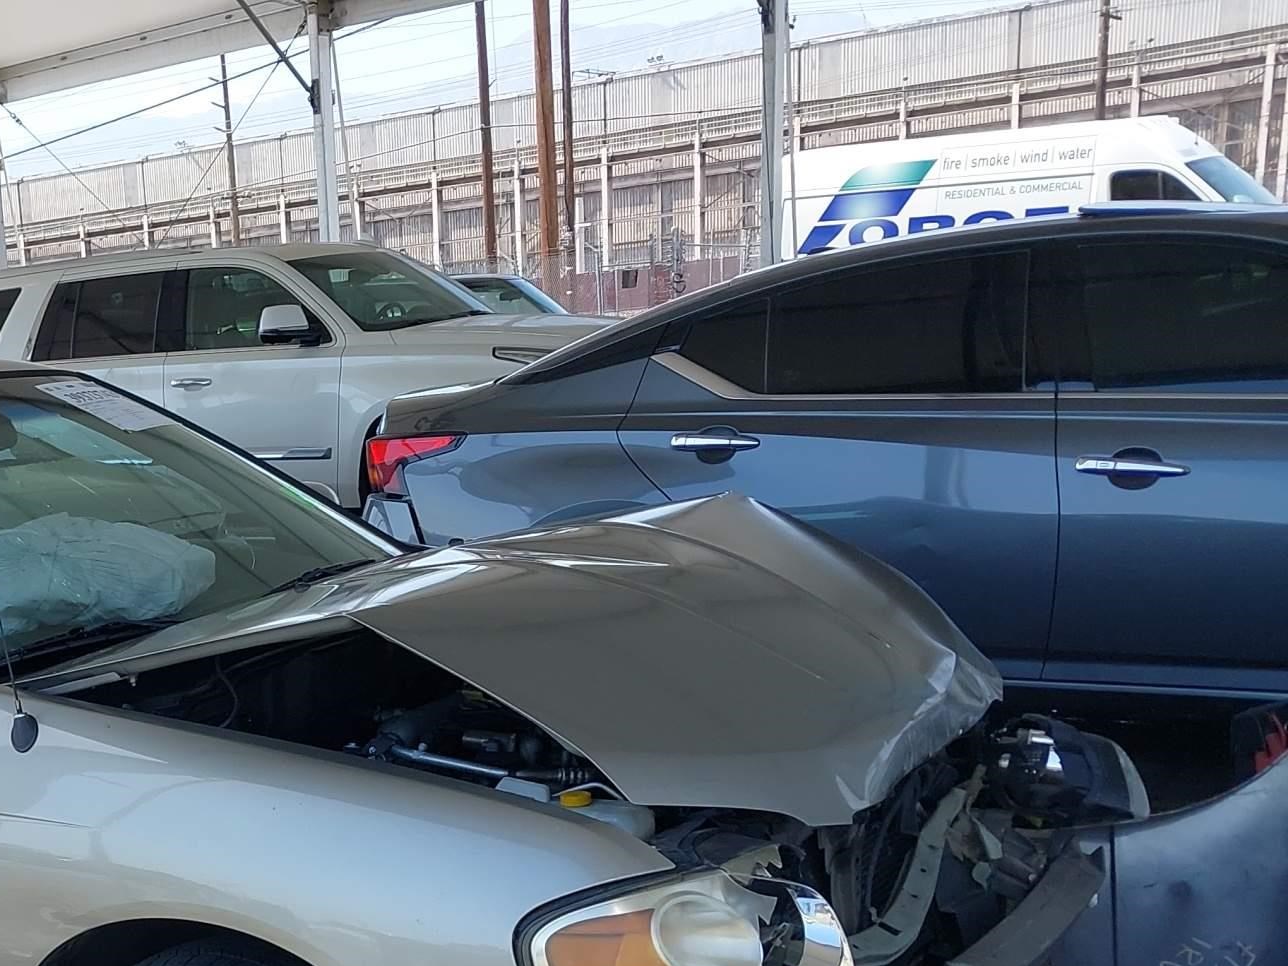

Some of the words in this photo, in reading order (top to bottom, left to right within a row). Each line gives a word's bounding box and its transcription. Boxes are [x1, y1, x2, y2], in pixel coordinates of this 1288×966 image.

[943, 158, 962, 171] fire
[971, 154, 1010, 168] smoke
[1020, 149, 1049, 163] wind
[1059, 146, 1093, 160] water
[944, 185, 1007, 200] RESIDENTIAL
[1010, 184, 1017, 195] &
[1019, 180, 1083, 194] COMMERCIAL
